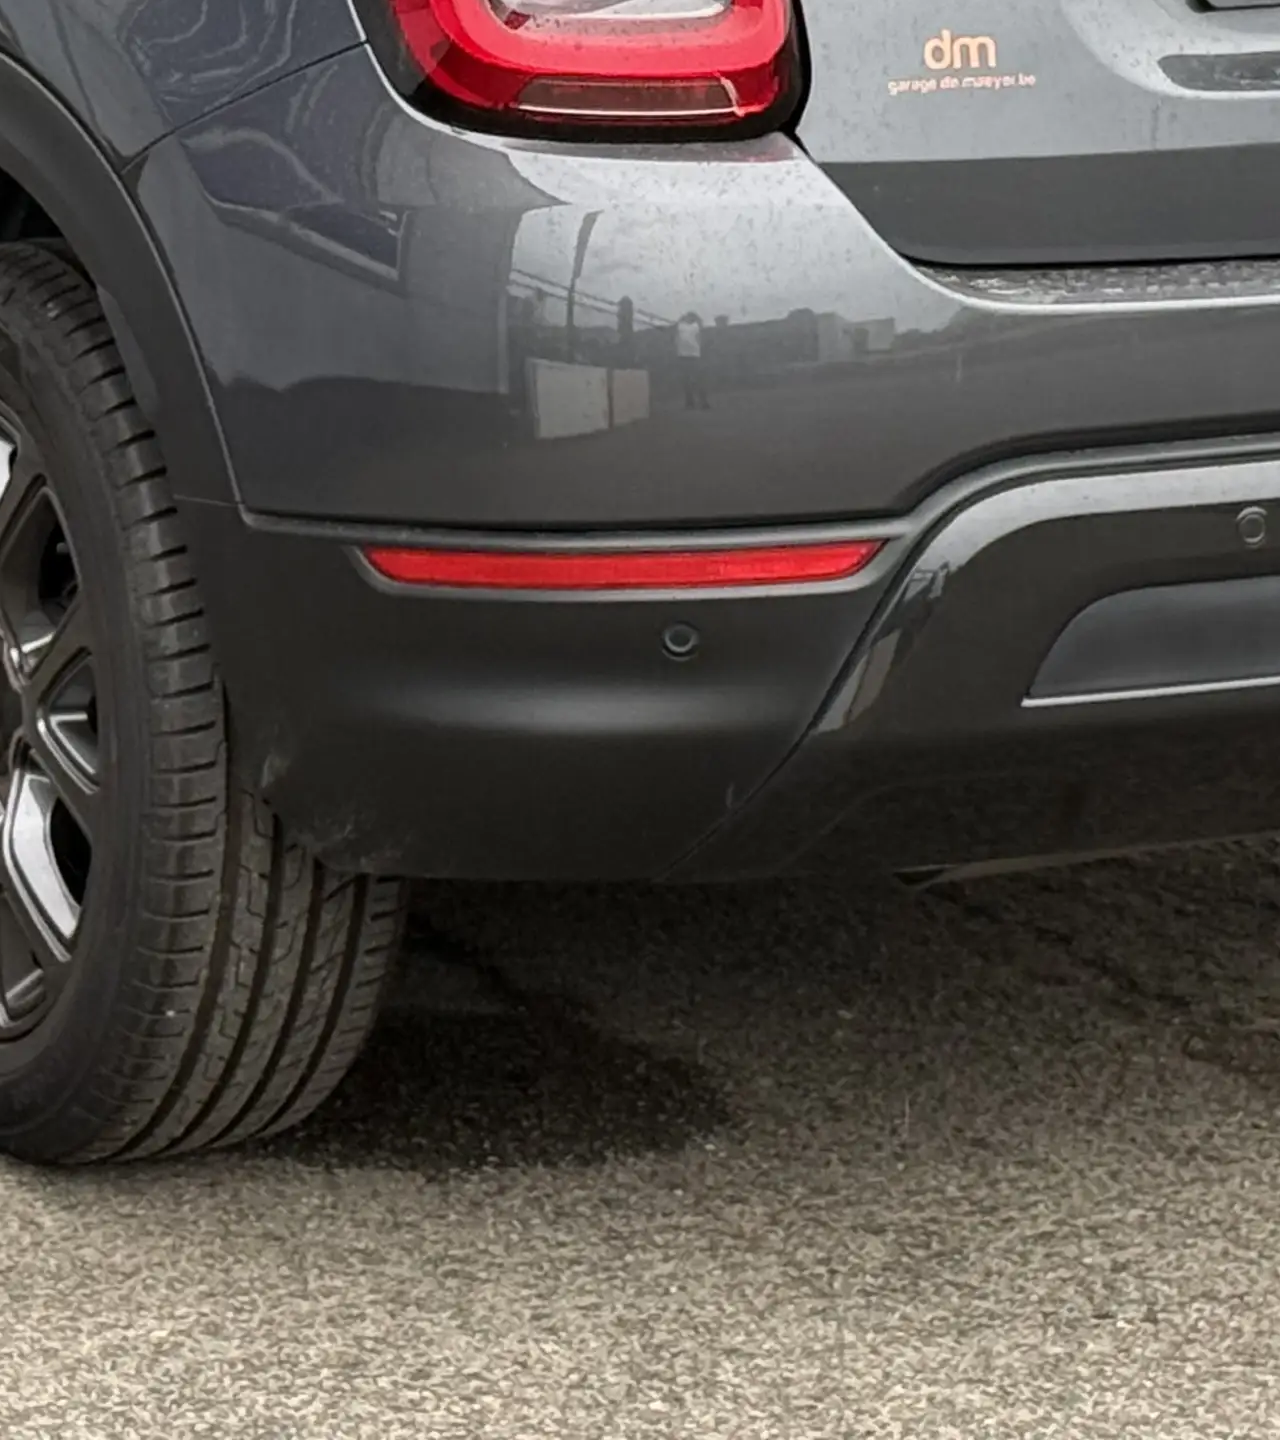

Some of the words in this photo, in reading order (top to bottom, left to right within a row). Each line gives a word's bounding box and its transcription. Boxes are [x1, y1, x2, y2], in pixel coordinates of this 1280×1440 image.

[924, 29, 996, 70] dm
[888, 78, 937, 96] garage
[940, 76, 959, 89] de
